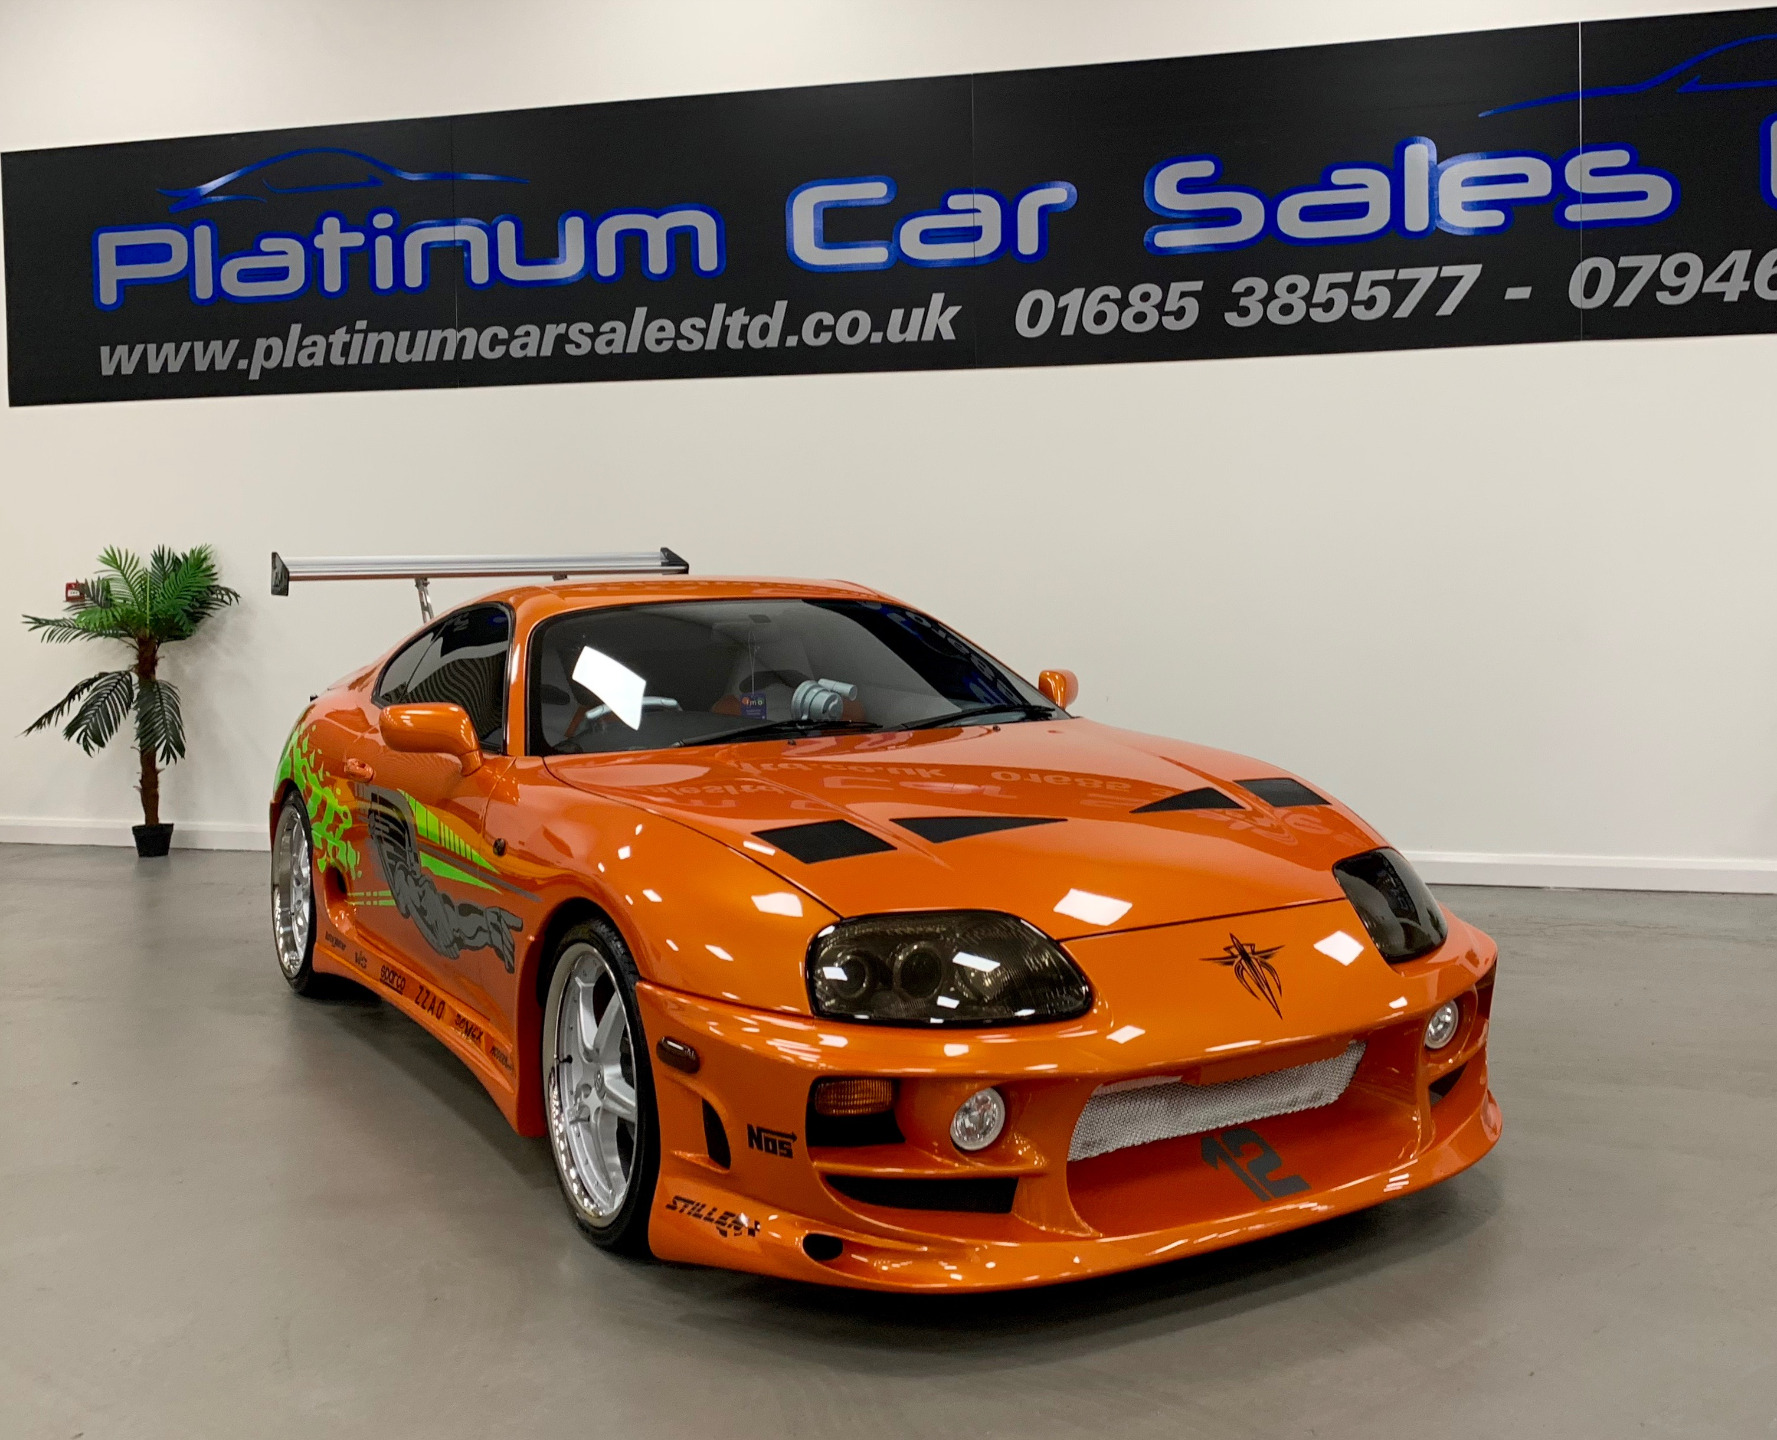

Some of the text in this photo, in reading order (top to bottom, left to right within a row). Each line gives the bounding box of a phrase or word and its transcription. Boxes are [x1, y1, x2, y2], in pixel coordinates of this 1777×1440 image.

[92, 203, 725, 311] Platinum
[785, 175, 1078, 272] Car
[1144, 136, 1681, 255] Sales
[100, 293, 963, 380] www.platinumcarsalesltd.co.uk
[1014, 280, 1203, 338] 01685
[1224, 264, 1482, 327] 385577
[1567, 248, 1777, 310] 07946
[747, 1123, 794, 1160] NOS
[1201, 1128, 1312, 1202] 12
